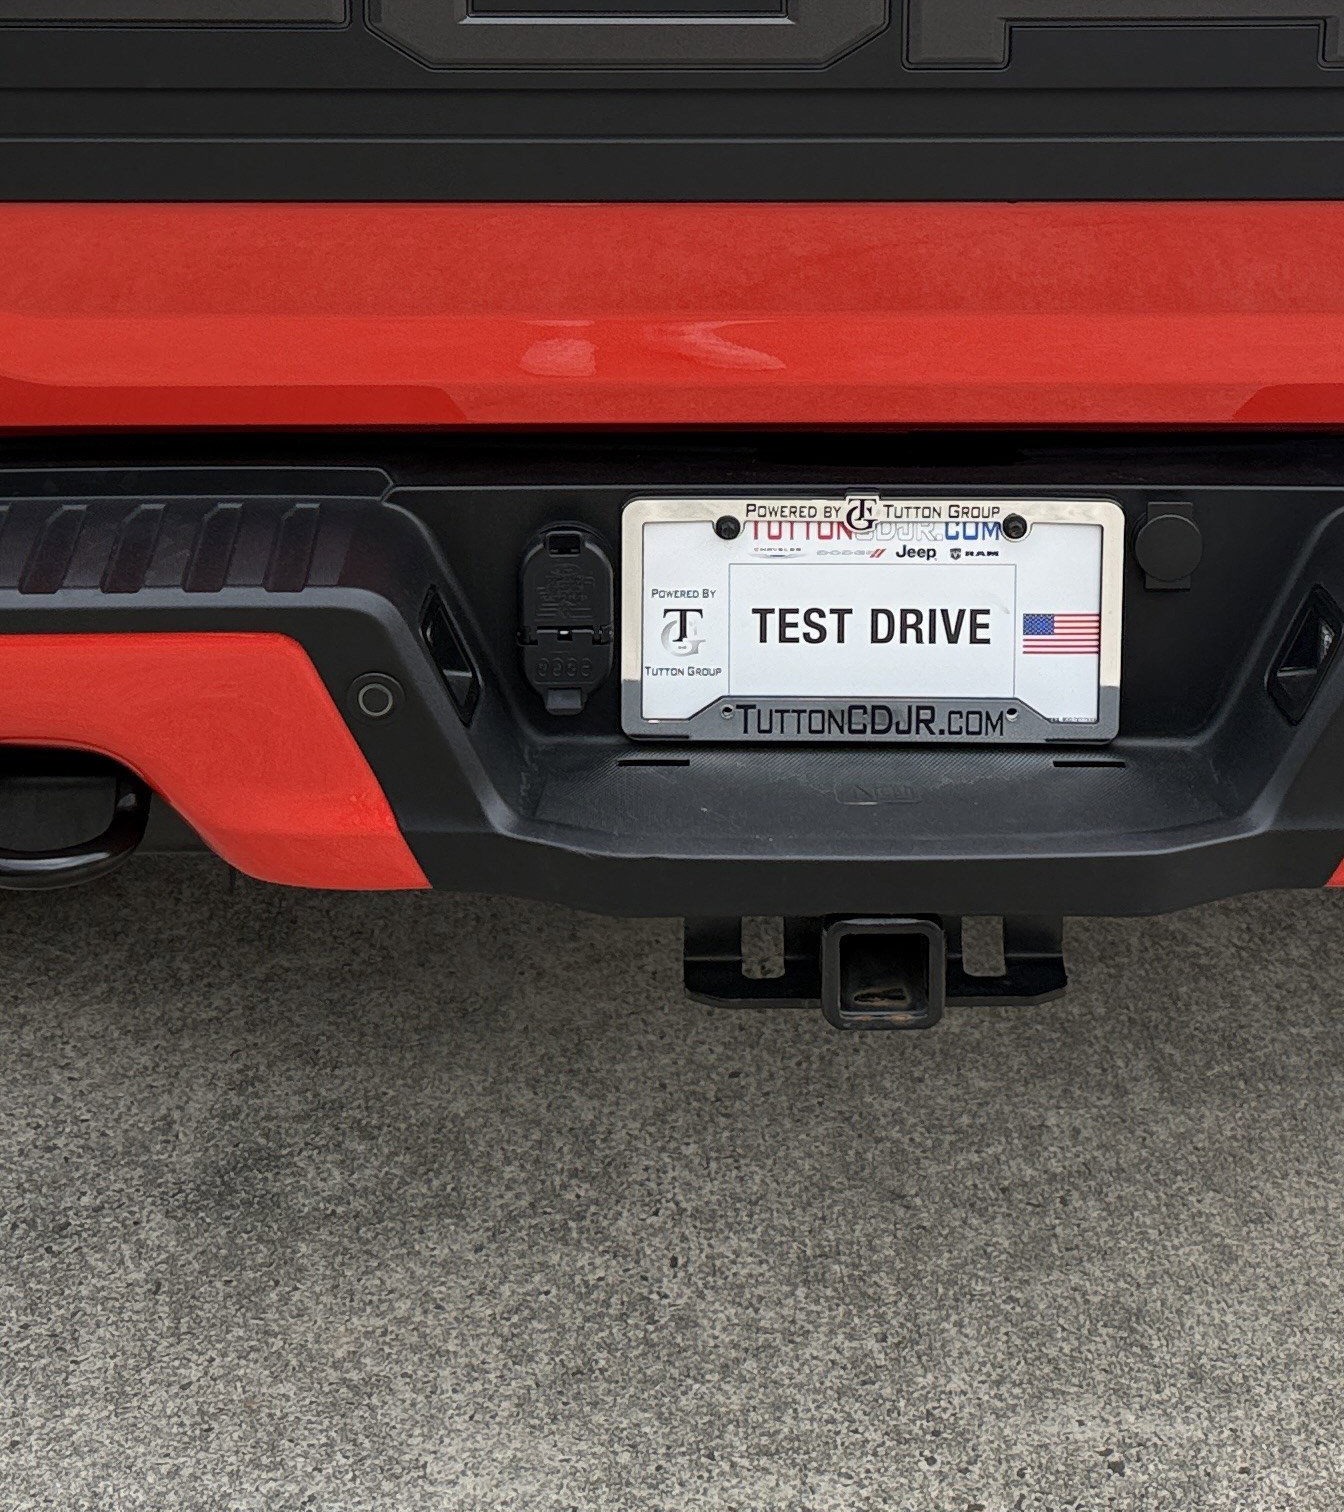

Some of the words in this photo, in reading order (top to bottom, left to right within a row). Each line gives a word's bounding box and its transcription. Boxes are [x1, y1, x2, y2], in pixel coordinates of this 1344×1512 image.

[883, 504, 943, 519] TUTTON
[948, 504, 1001, 519] GROUP
[753, 521, 1001, 542] TUTTONDJR.COM
[896, 544, 937, 561] Jeep
[752, 608, 853, 645] TEST
[870, 608, 991, 645] DRIVE
[645, 666, 685, 676] TUTTON
[687, 666, 723, 676] GROUP
